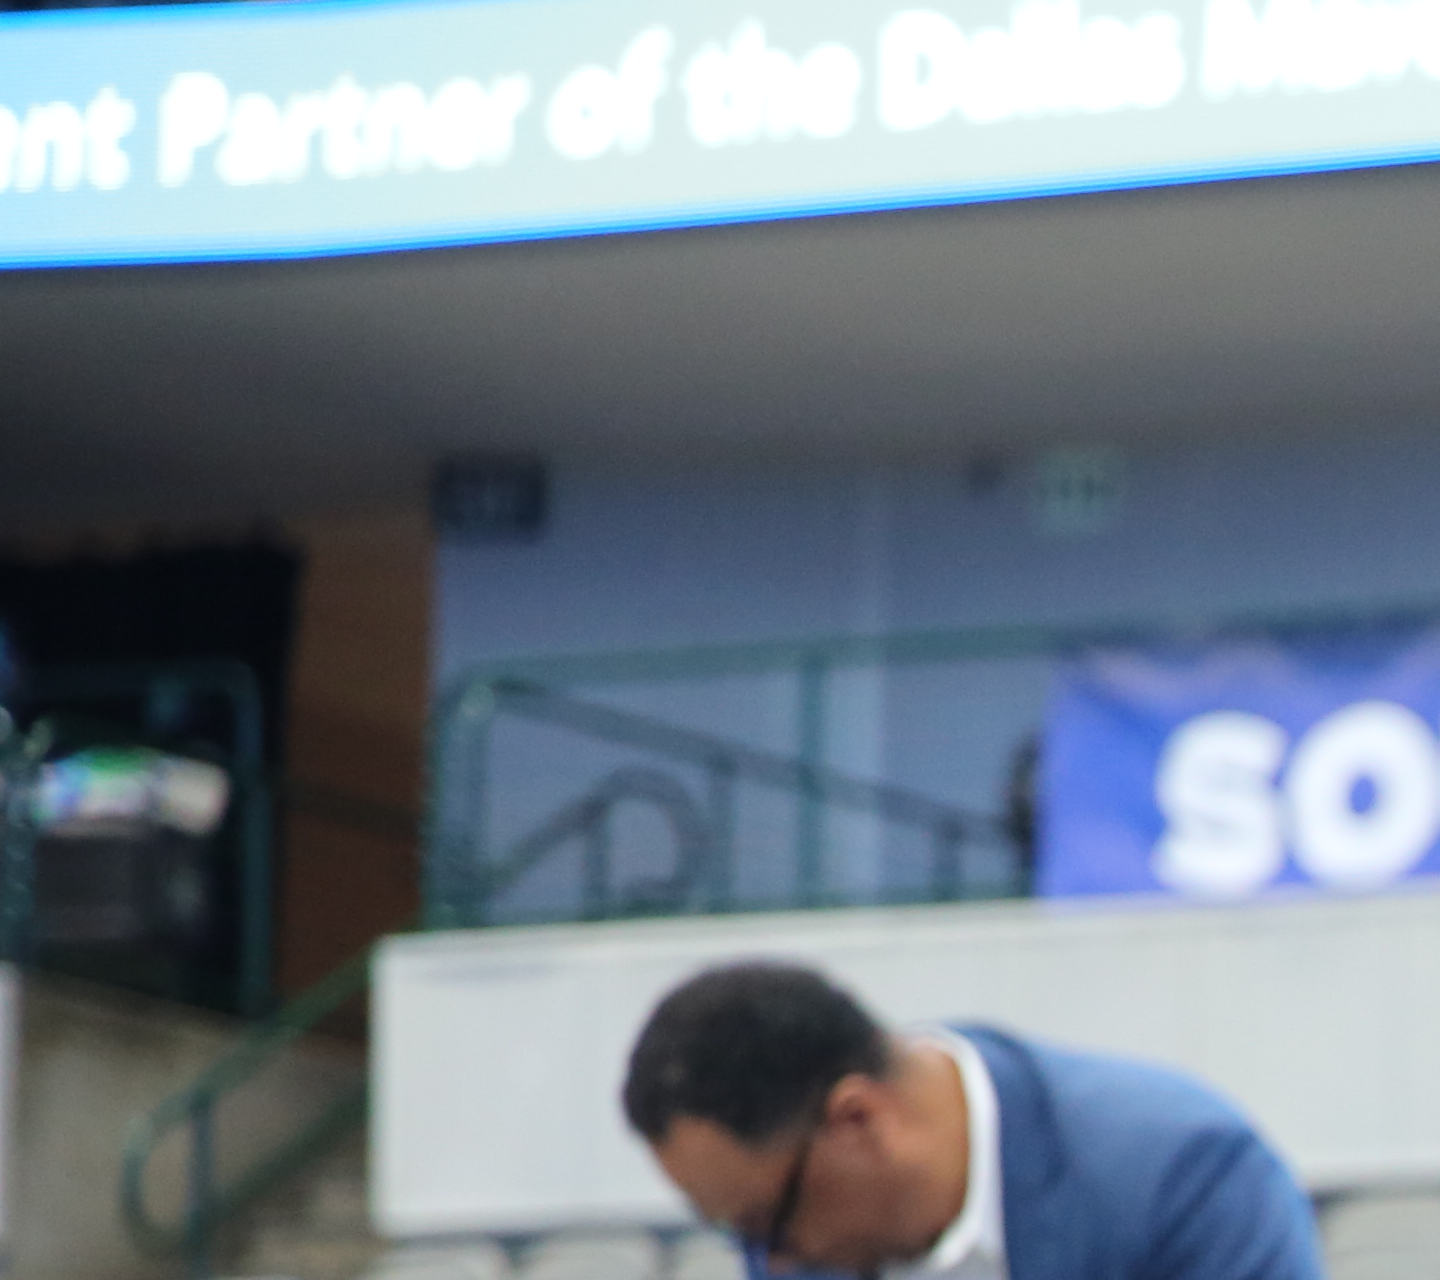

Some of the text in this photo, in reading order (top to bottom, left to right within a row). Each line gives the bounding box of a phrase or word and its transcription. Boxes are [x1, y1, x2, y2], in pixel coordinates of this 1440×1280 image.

[0, 84, 134, 192] nt
[160, 71, 530, 186] Partner
[546, 26, 673, 158] of
[683, 19, 862, 146] the
[878, 0, 1188, 130] Dallas
